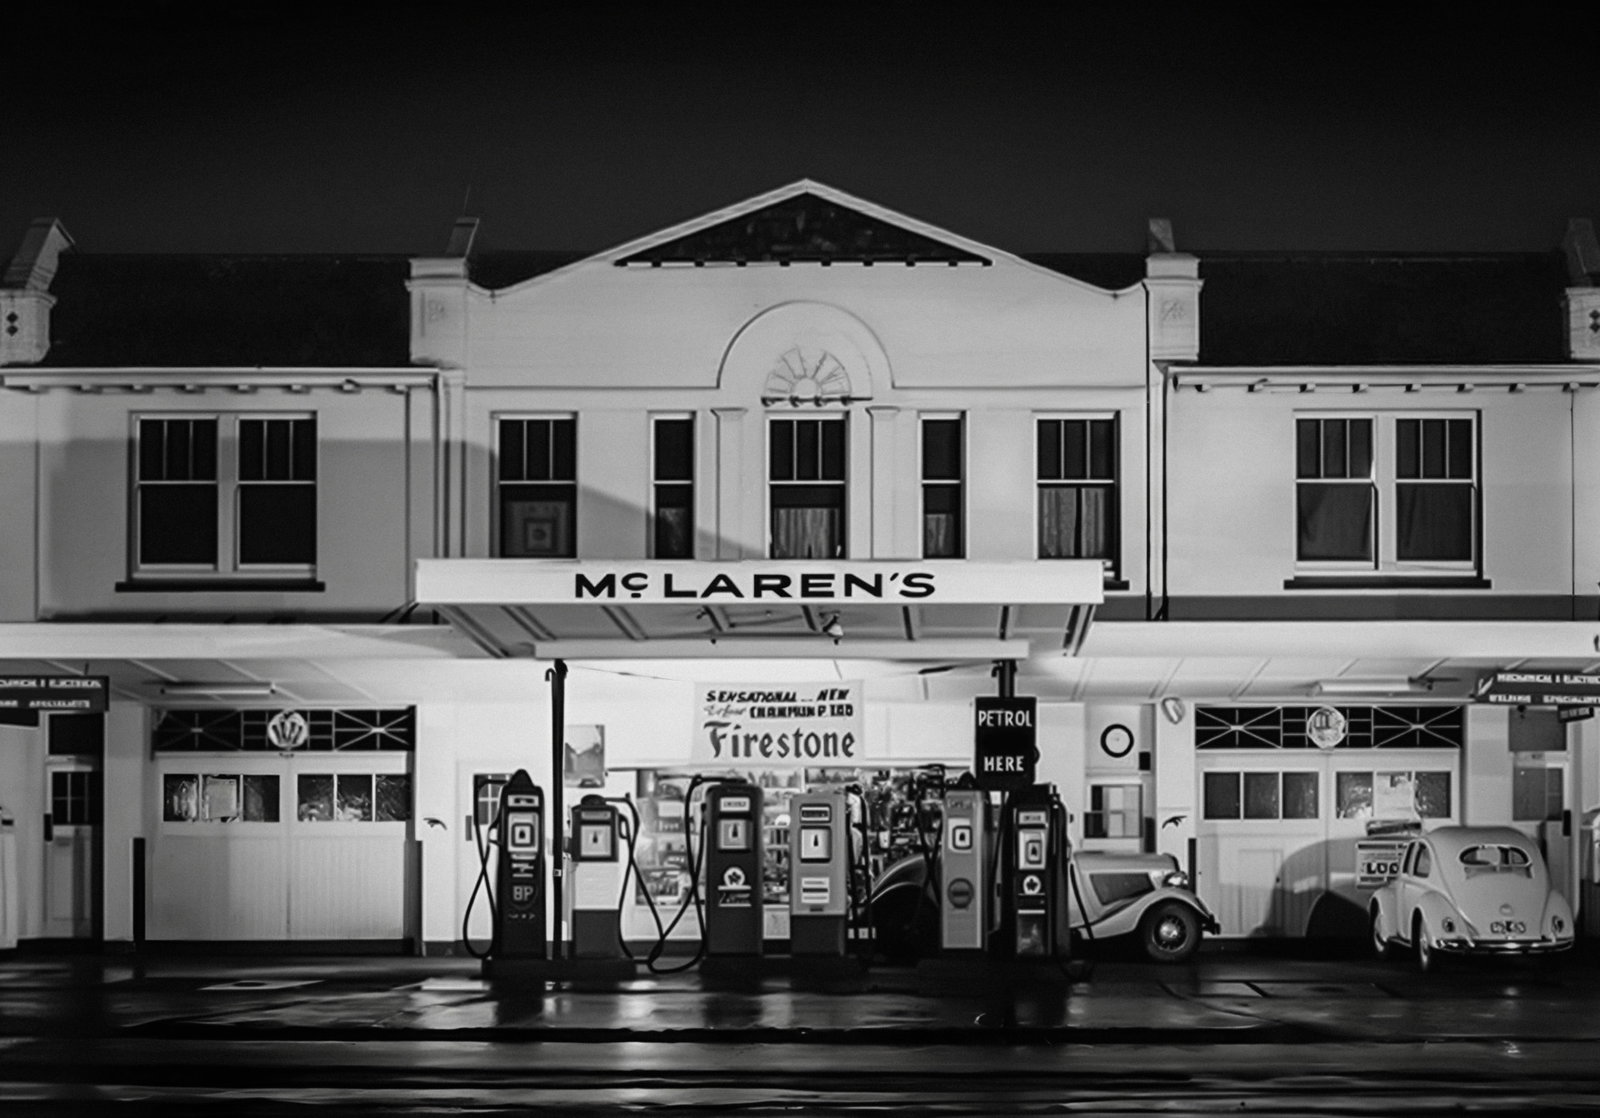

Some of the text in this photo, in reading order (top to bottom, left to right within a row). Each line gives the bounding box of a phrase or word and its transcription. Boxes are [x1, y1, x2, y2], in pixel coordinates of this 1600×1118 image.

[816, 688, 850, 702] NEW
[978, 709, 1033, 727] PETROL
[703, 720, 856, 759] Firestone
[984, 755, 1025, 772] HERE
[513, 885, 534, 901] BP
